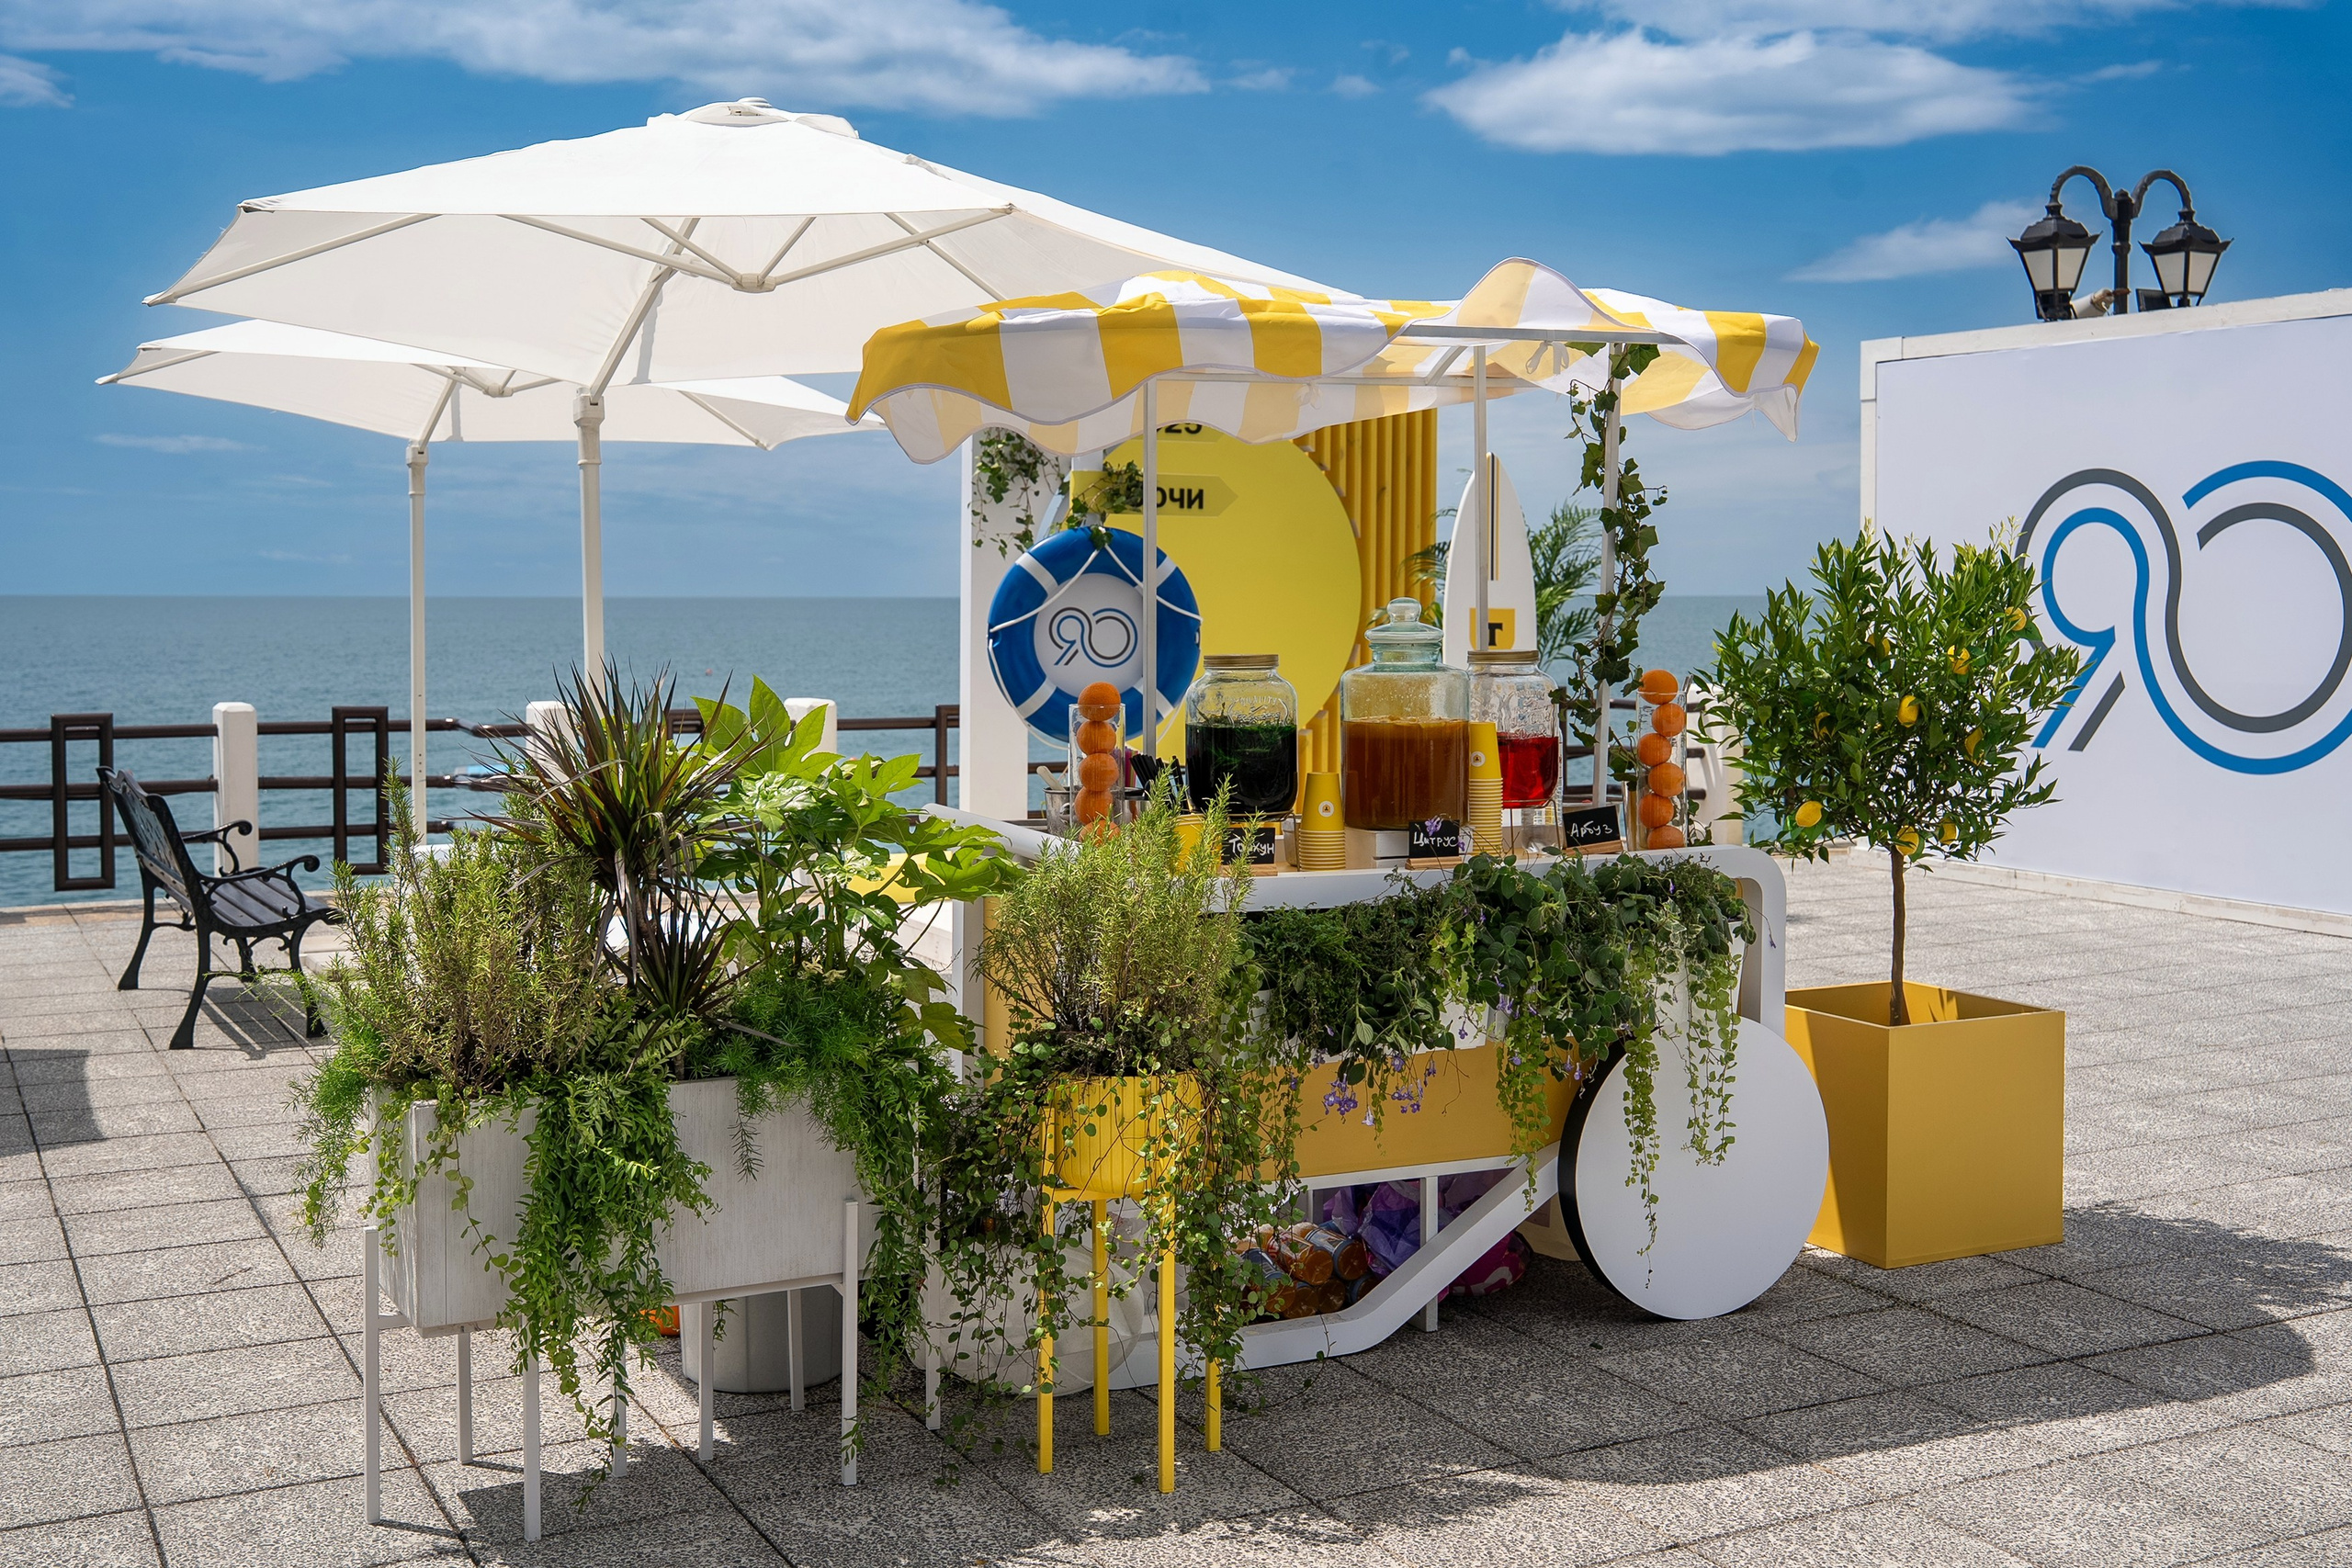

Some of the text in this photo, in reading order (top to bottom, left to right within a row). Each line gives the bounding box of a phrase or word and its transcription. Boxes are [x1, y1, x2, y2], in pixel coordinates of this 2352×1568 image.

[1157, 423, 1202, 434] 25
[1131, 487, 1204, 510] ОЧИ
[1049, 606, 1138, 668] 90
[1570, 820, 1612, 838] Арбуз
[1413, 831, 1458, 848] Цитрус
